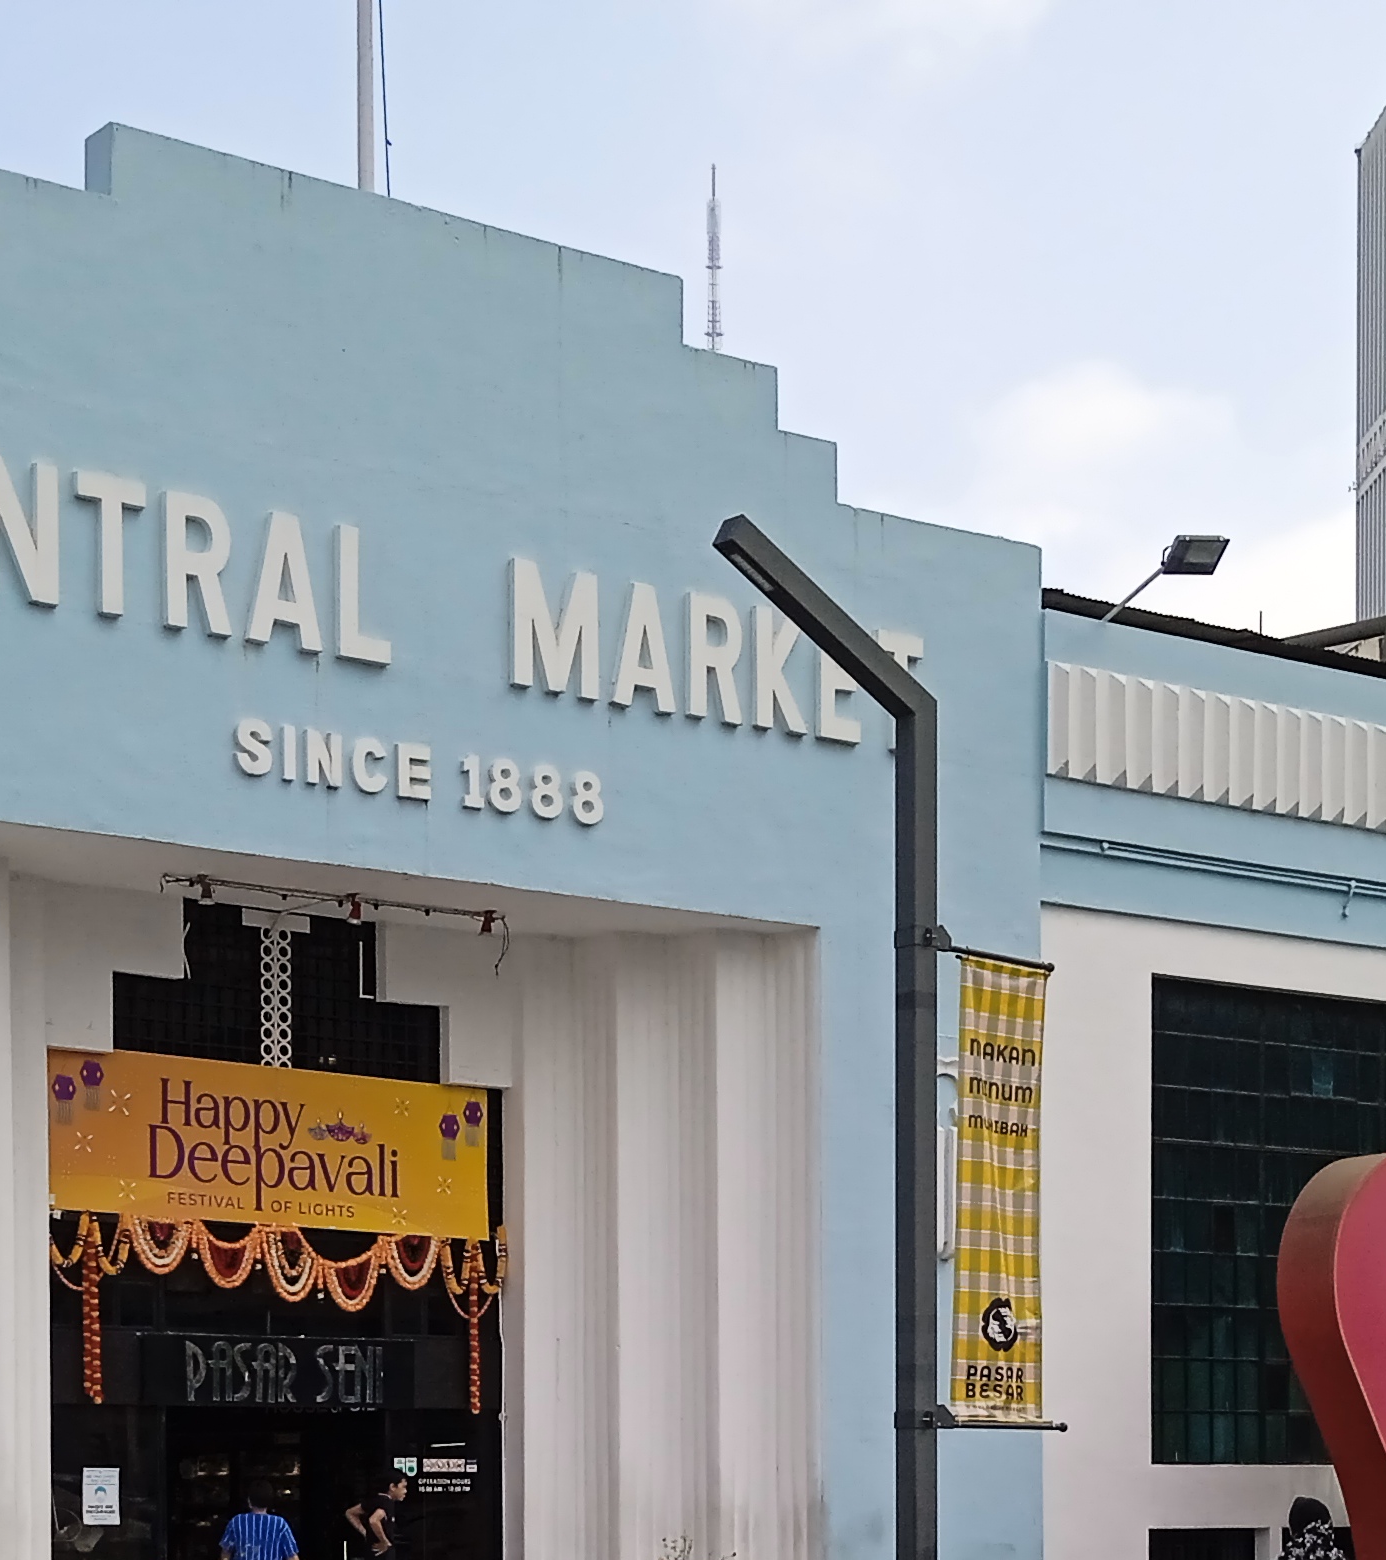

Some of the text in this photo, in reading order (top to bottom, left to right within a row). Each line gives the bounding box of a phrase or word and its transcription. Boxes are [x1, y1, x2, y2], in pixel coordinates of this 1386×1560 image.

[234, 717, 604, 825] SINCE 1888
[159, 1078, 305, 1150] Happy
[148, 1124, 400, 1211] Deepavali
[167, 1192, 355, 1218] FESTIVAL OF LIGHTS
[185, 1340, 384, 1404] PASAR SENI
[965, 1382, 1024, 1401] BESAR
[967, 1365, 1024, 1384] PASAR
